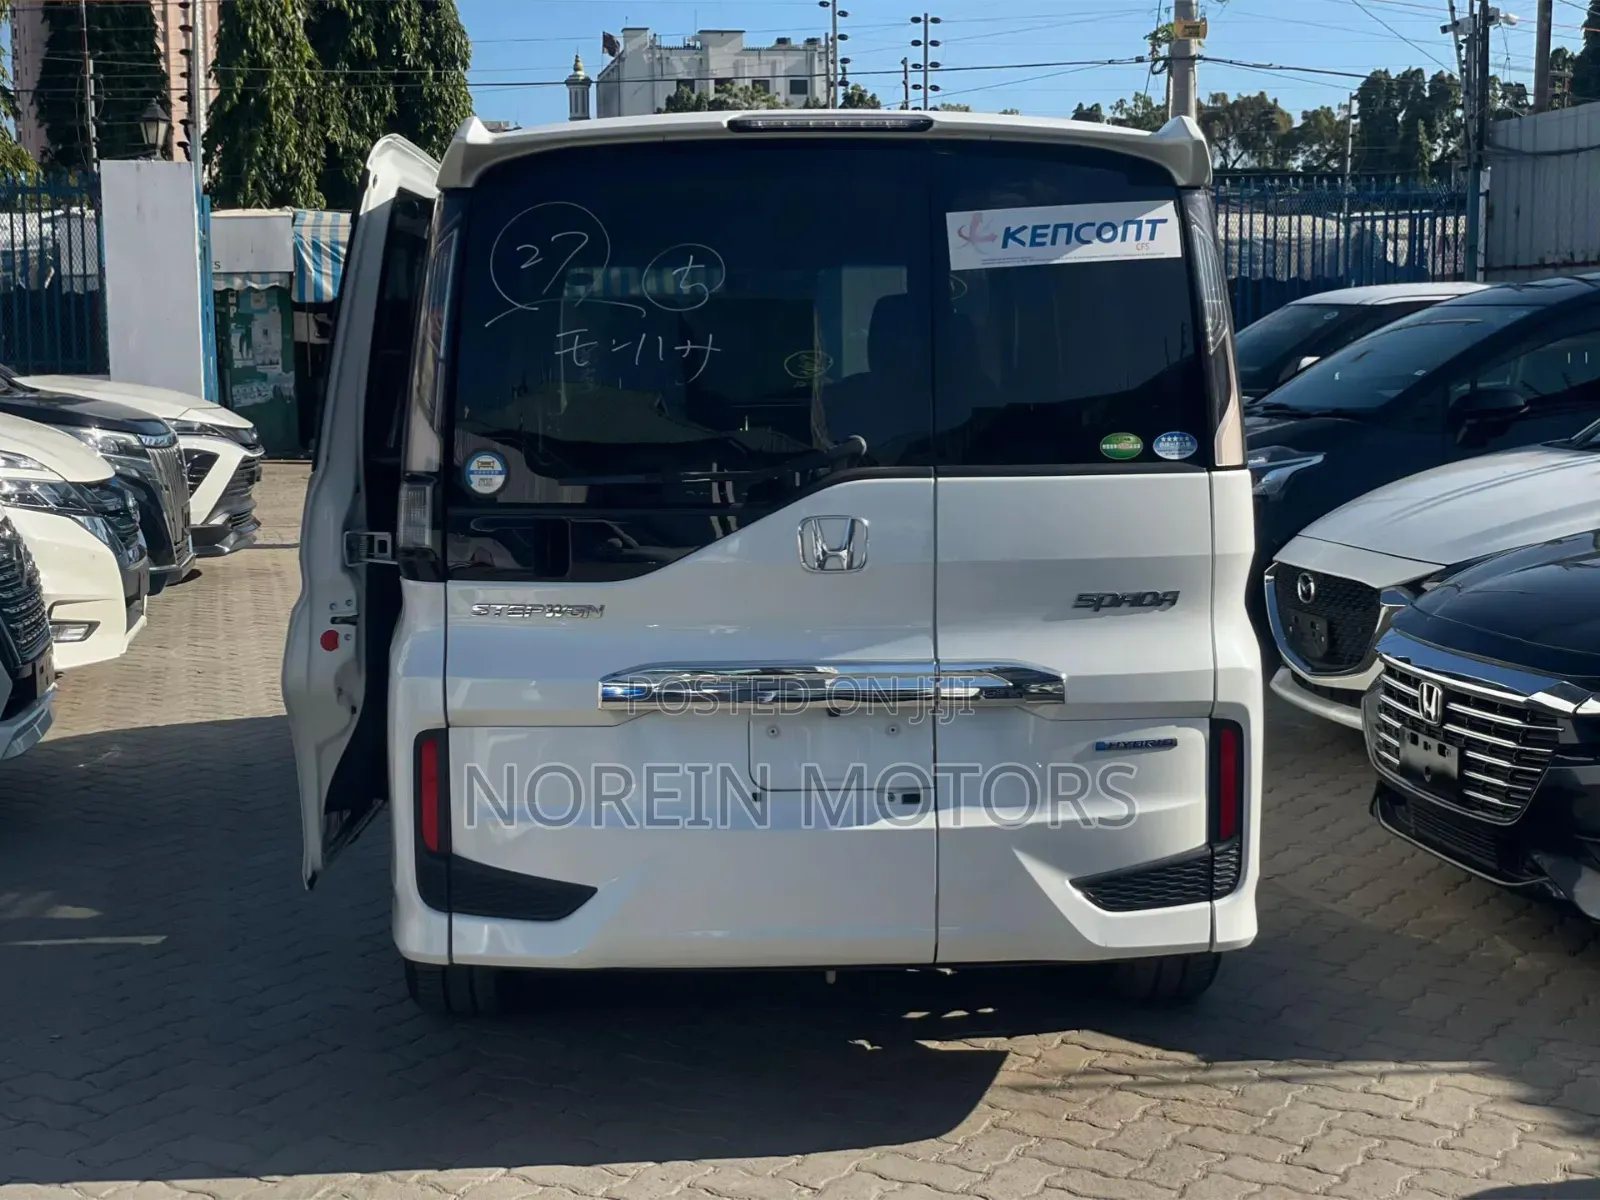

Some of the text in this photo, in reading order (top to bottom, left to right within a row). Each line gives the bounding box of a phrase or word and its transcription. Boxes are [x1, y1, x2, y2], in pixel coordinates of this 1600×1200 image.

[516, 231, 589, 295] 27
[470, 603, 606, 619] STEPWGN
[1071, 590, 1181, 612] SPADA
